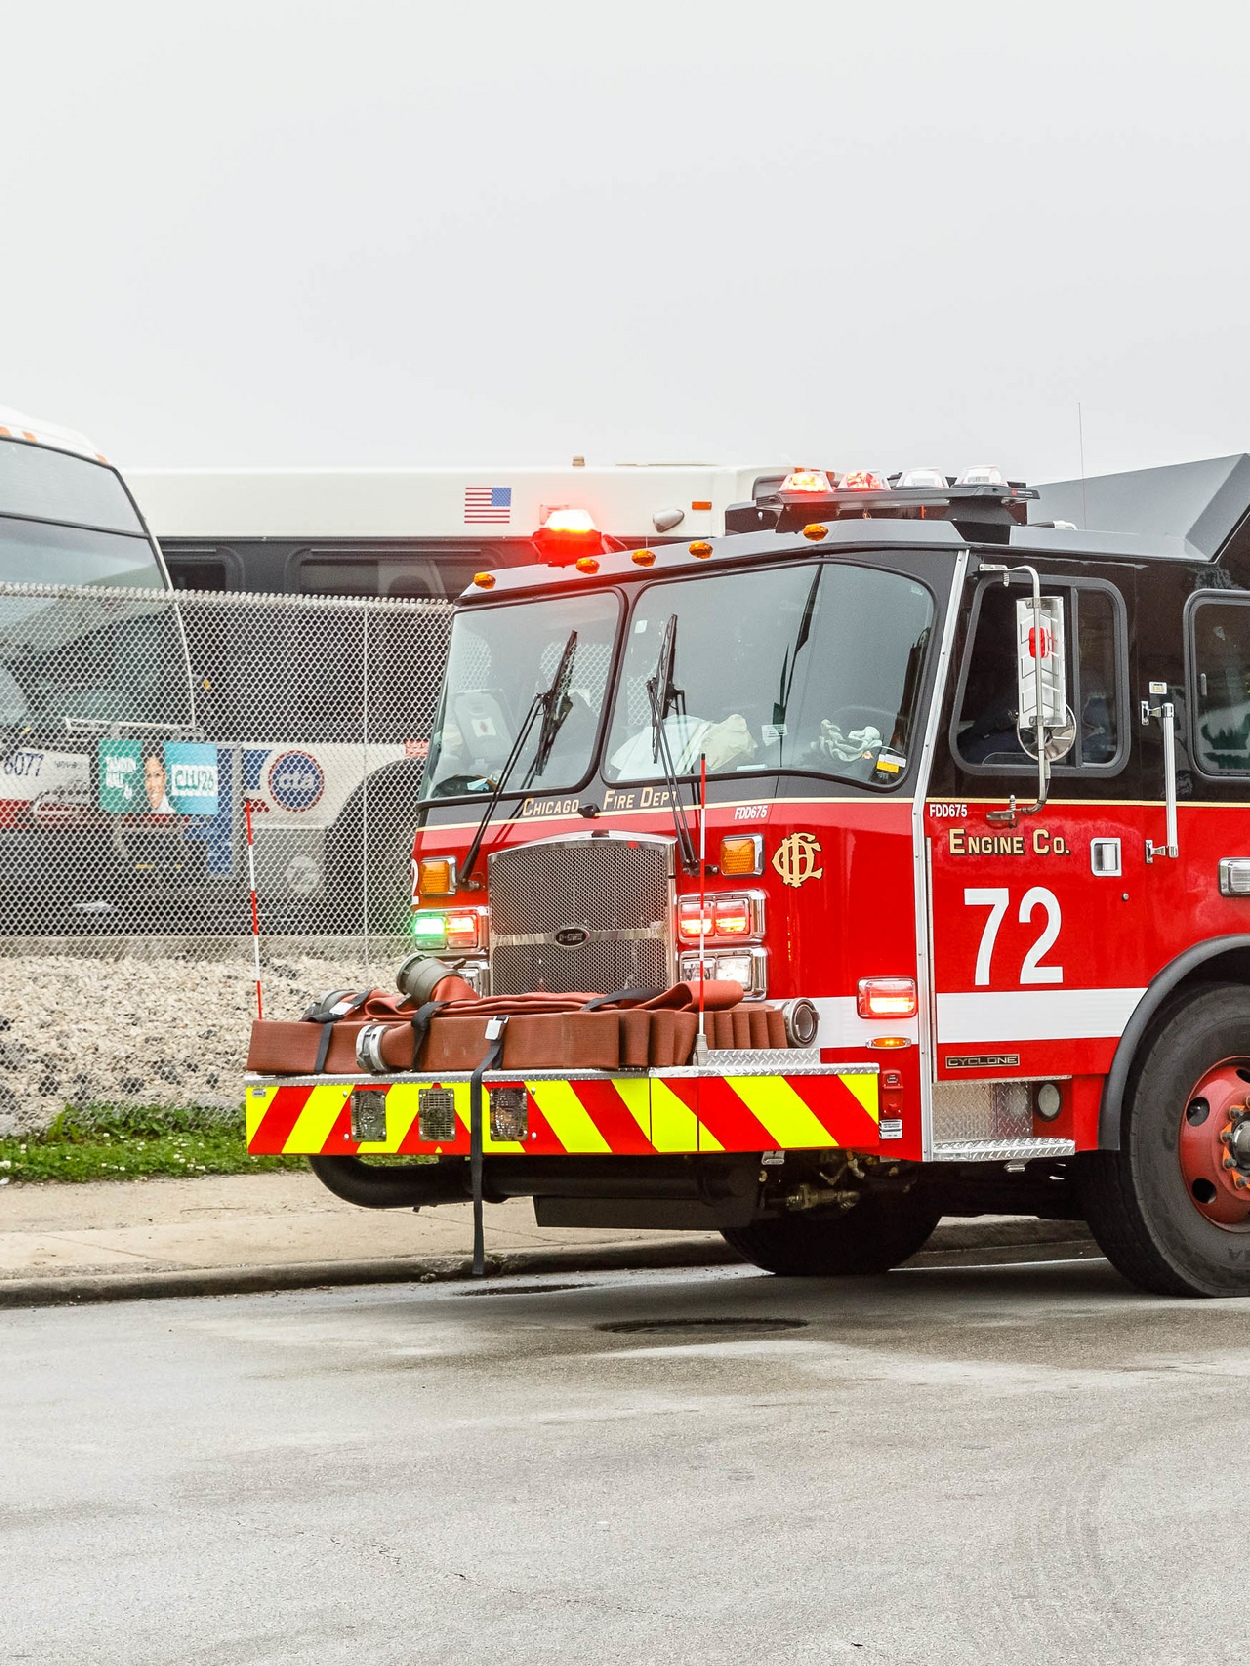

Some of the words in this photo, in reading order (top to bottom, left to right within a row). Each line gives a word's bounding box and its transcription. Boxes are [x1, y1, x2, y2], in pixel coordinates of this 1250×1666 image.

[523, 798, 580, 816] CHICAGO
[603, 790, 635, 810] FIRE
[734, 805, 768, 820] FDD675
[929, 804, 967, 817] FDD675
[949, 829, 1024, 855] ENGINE
[1032, 829, 1071, 855] CO.
[964, 886, 1064, 986] 72
[947, 1056, 1018, 1066] CYCLONE
